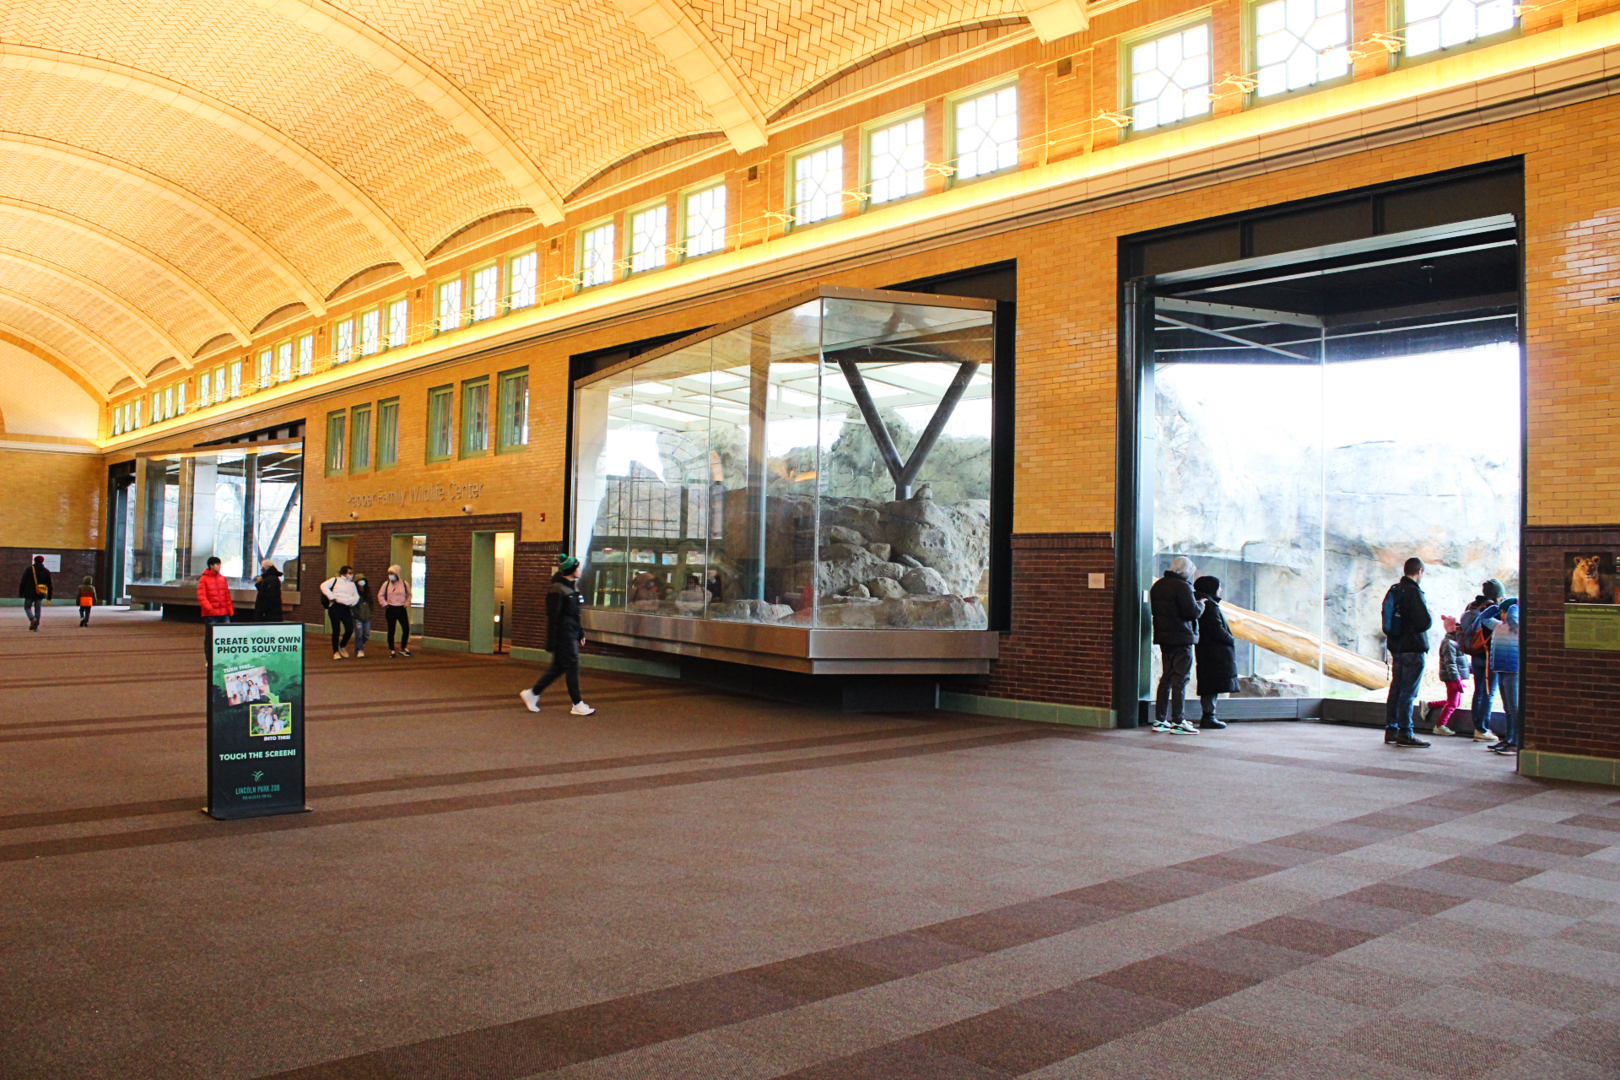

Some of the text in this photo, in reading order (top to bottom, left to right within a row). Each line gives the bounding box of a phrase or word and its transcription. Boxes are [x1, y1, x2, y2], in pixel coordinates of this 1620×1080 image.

[347, 481, 484, 508] Pepper Family Wildlife Center
[265, 749, 296, 758] SCREEN!
[236, 786, 256, 794] LINCOLN
